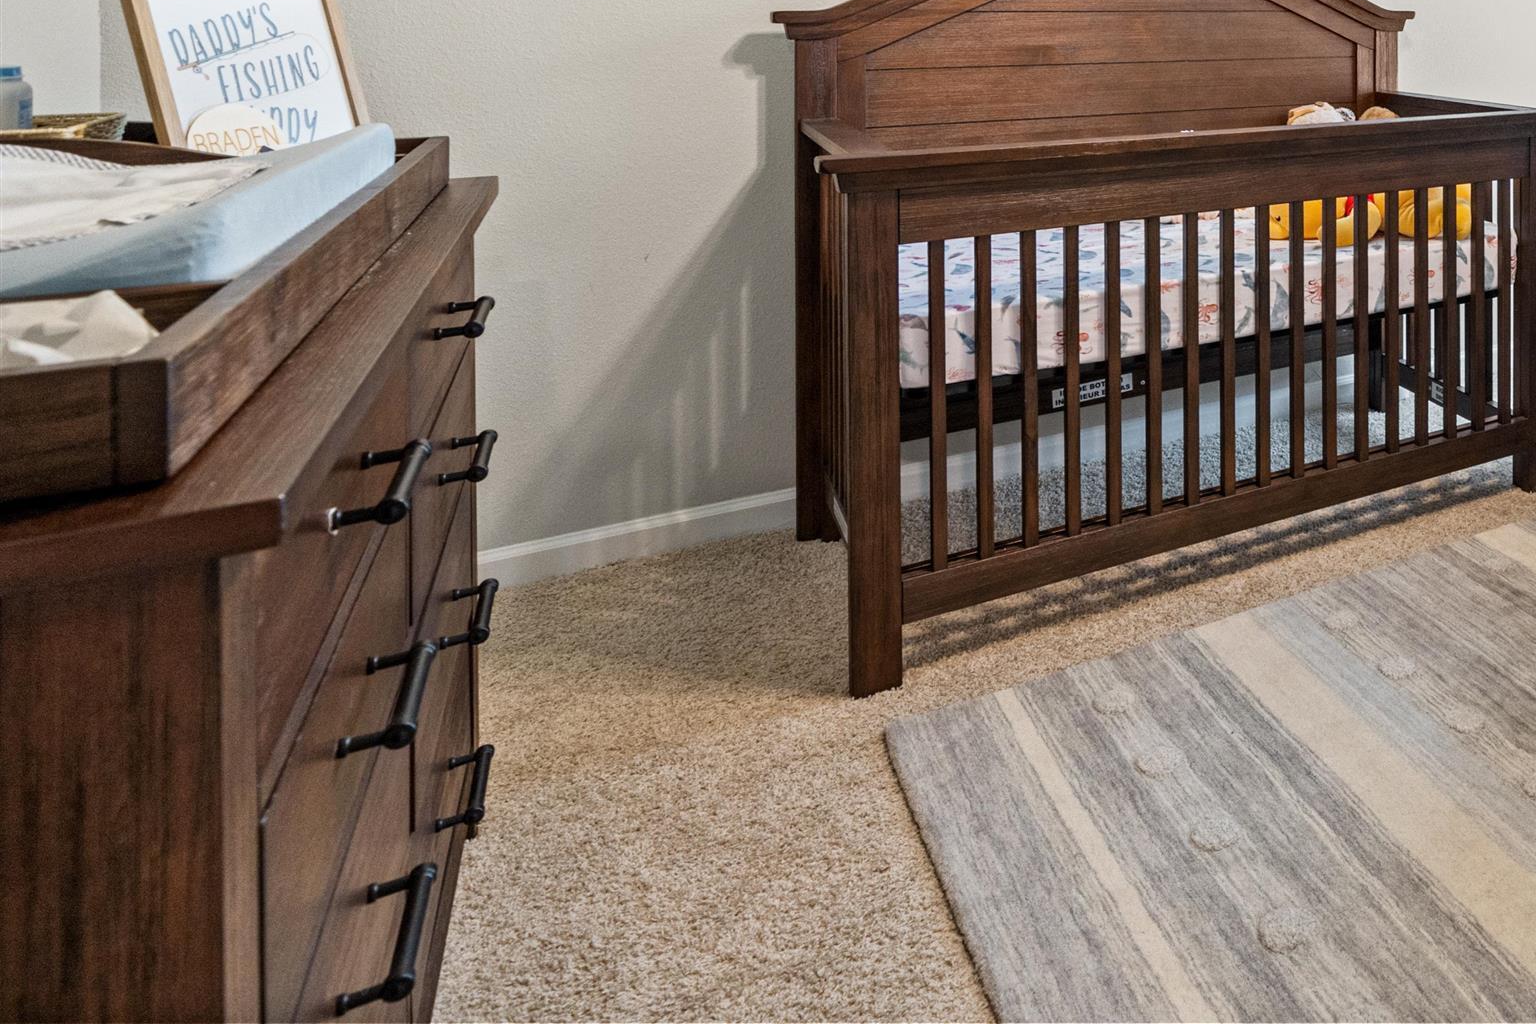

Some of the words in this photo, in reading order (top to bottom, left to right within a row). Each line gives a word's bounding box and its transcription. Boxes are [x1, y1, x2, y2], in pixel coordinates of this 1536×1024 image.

[168, 2, 280, 66] DADDY'S
[216, 44, 321, 104] FISHING
[193, 124, 280, 153] BRADEN
